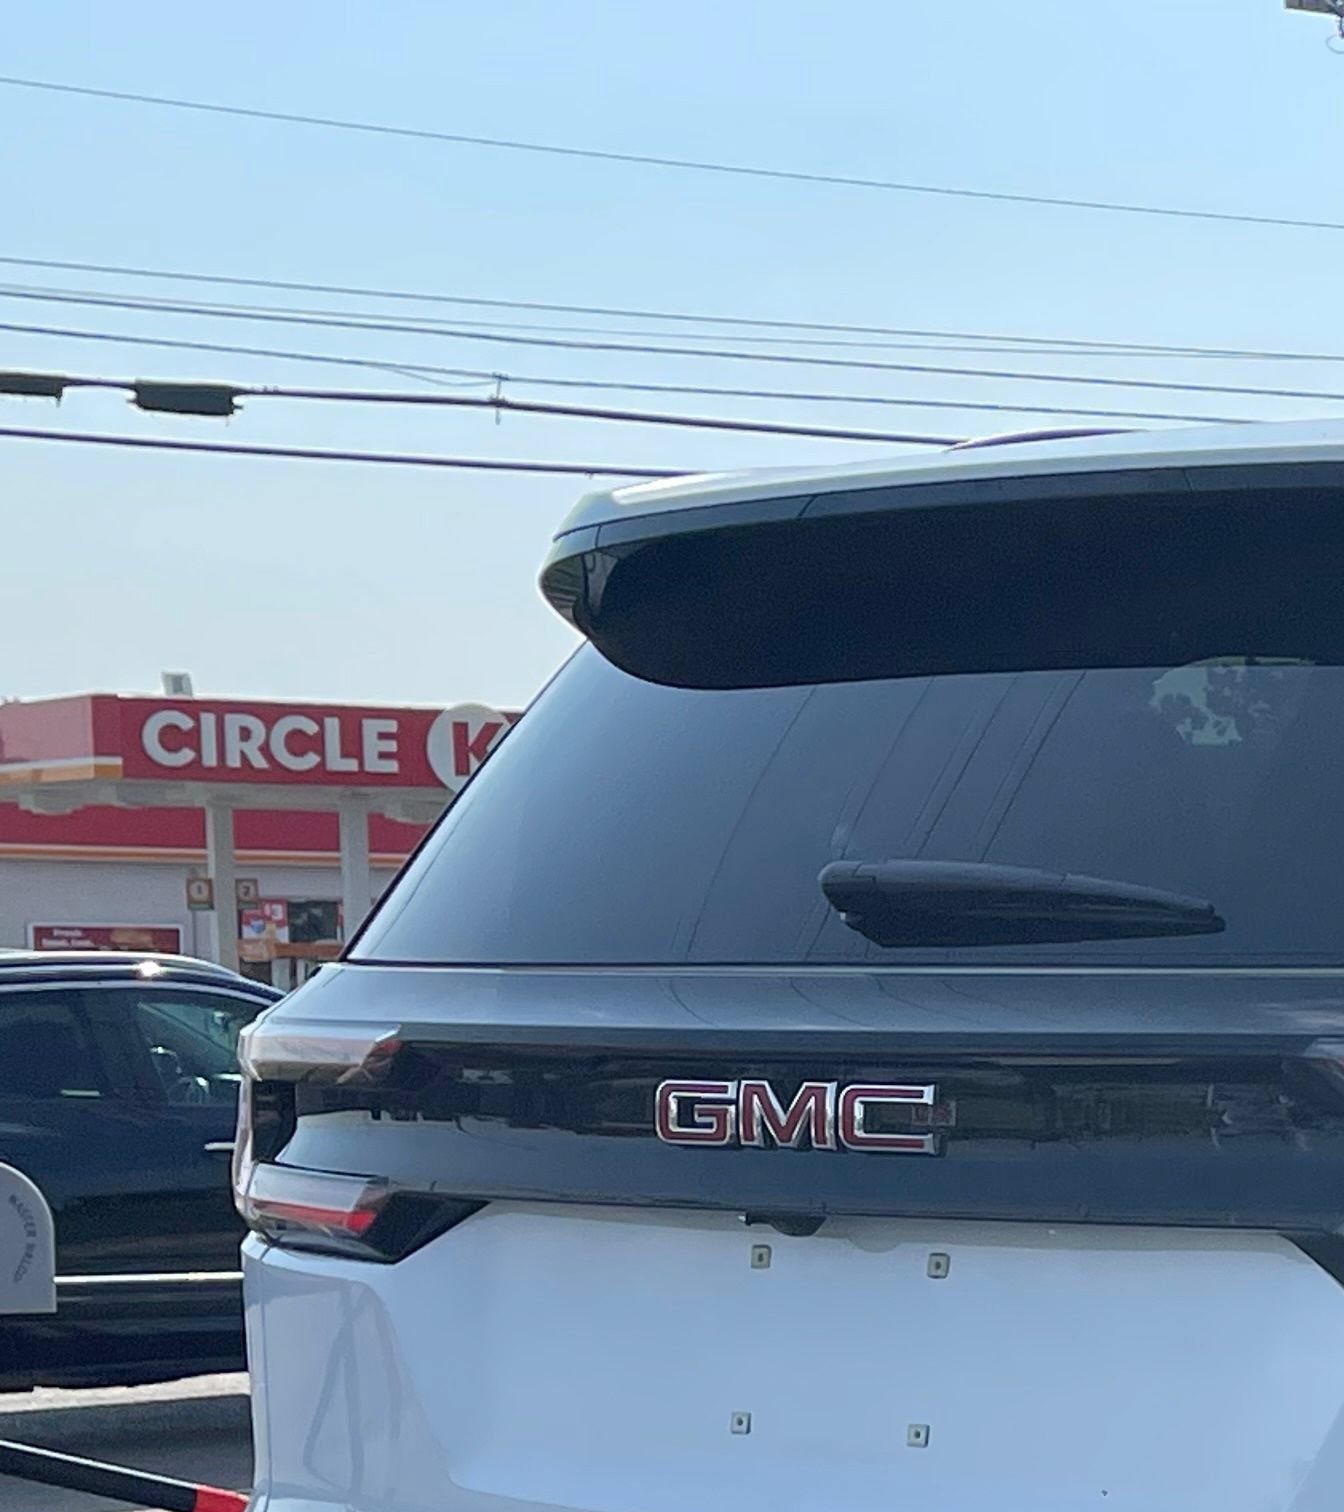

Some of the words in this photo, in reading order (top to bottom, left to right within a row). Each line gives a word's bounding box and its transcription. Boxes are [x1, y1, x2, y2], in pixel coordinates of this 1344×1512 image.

[141, 709, 399, 774] CIRCLE
[451, 721, 504, 777] K
[655, 1078, 937, 1155] GMC
